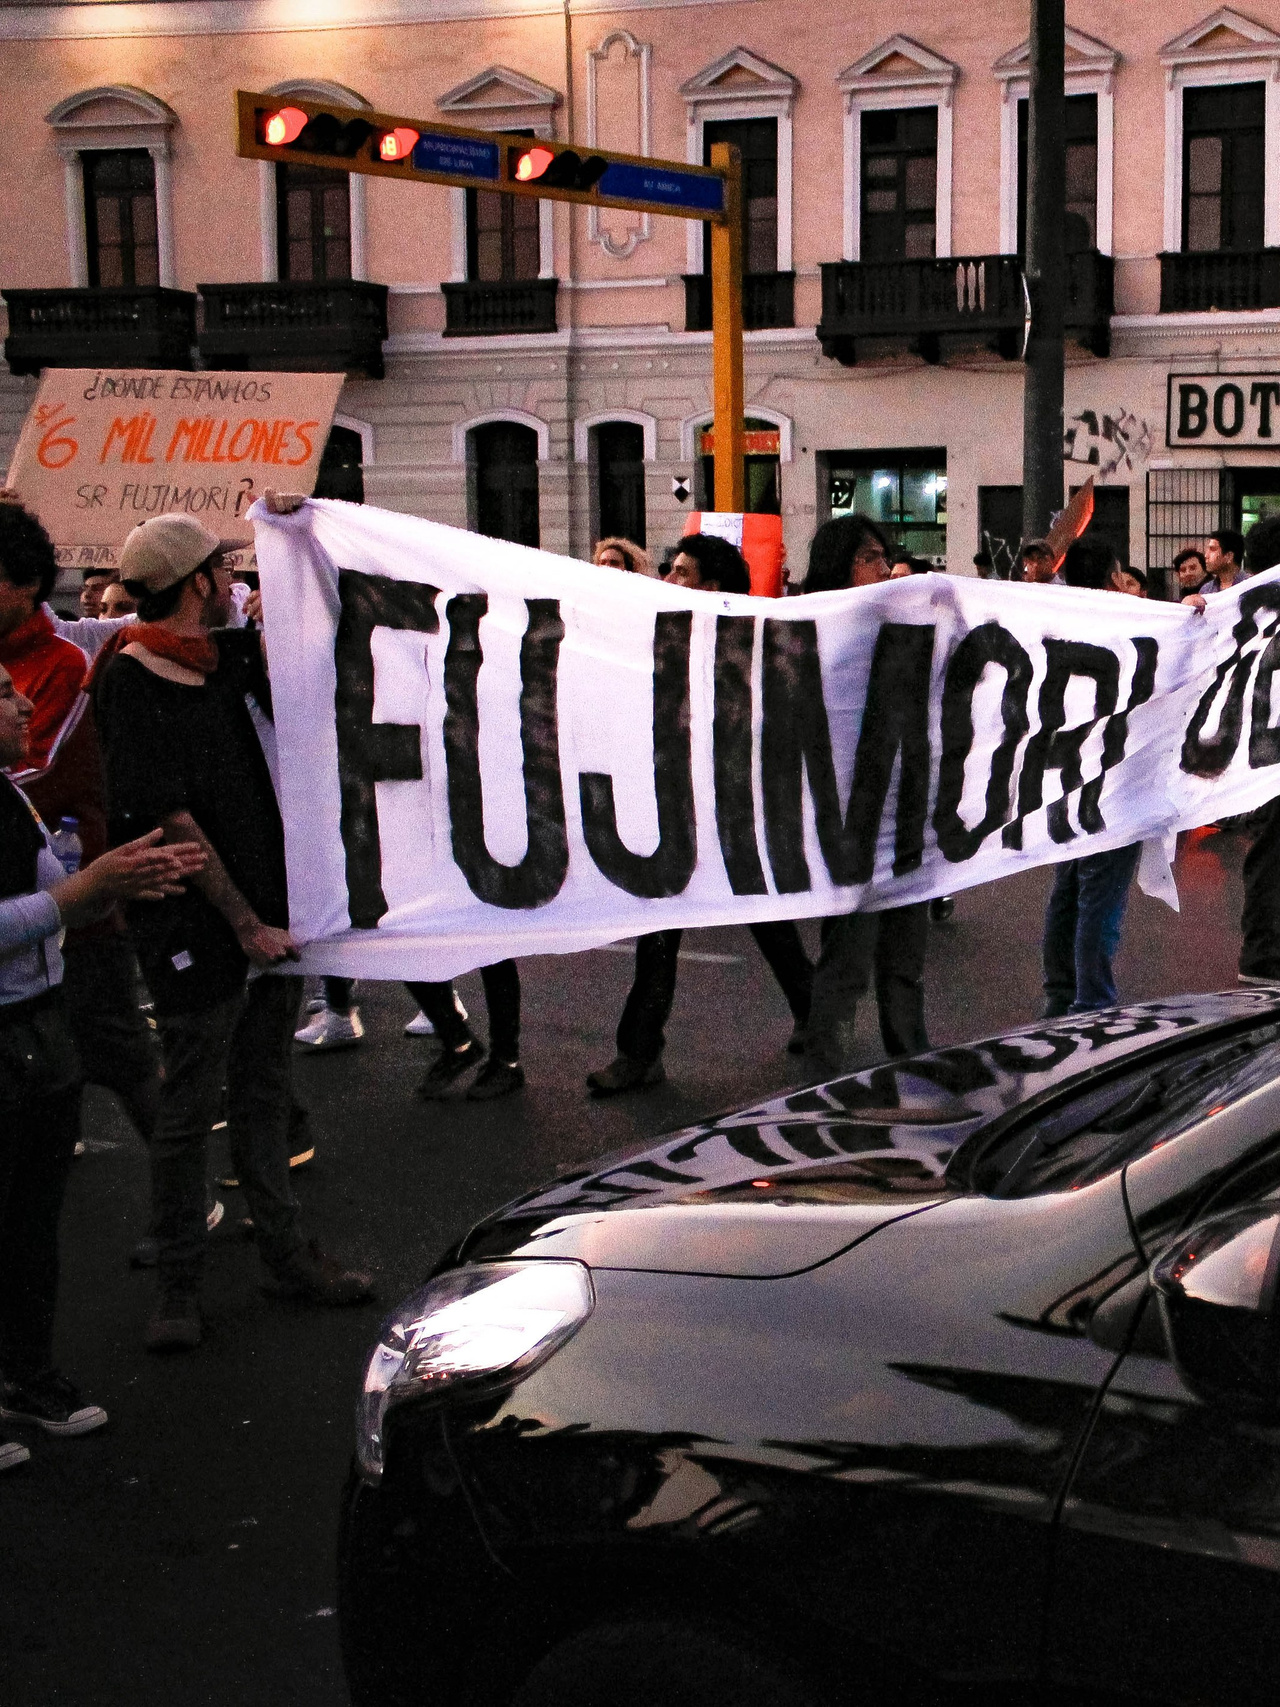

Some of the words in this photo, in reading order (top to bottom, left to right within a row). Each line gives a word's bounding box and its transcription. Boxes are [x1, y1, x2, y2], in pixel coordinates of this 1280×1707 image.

[100, 410, 158, 464] MIL
[165, 412, 320, 466] MILLONES
[335, 568, 1158, 929] FUJIMORI
